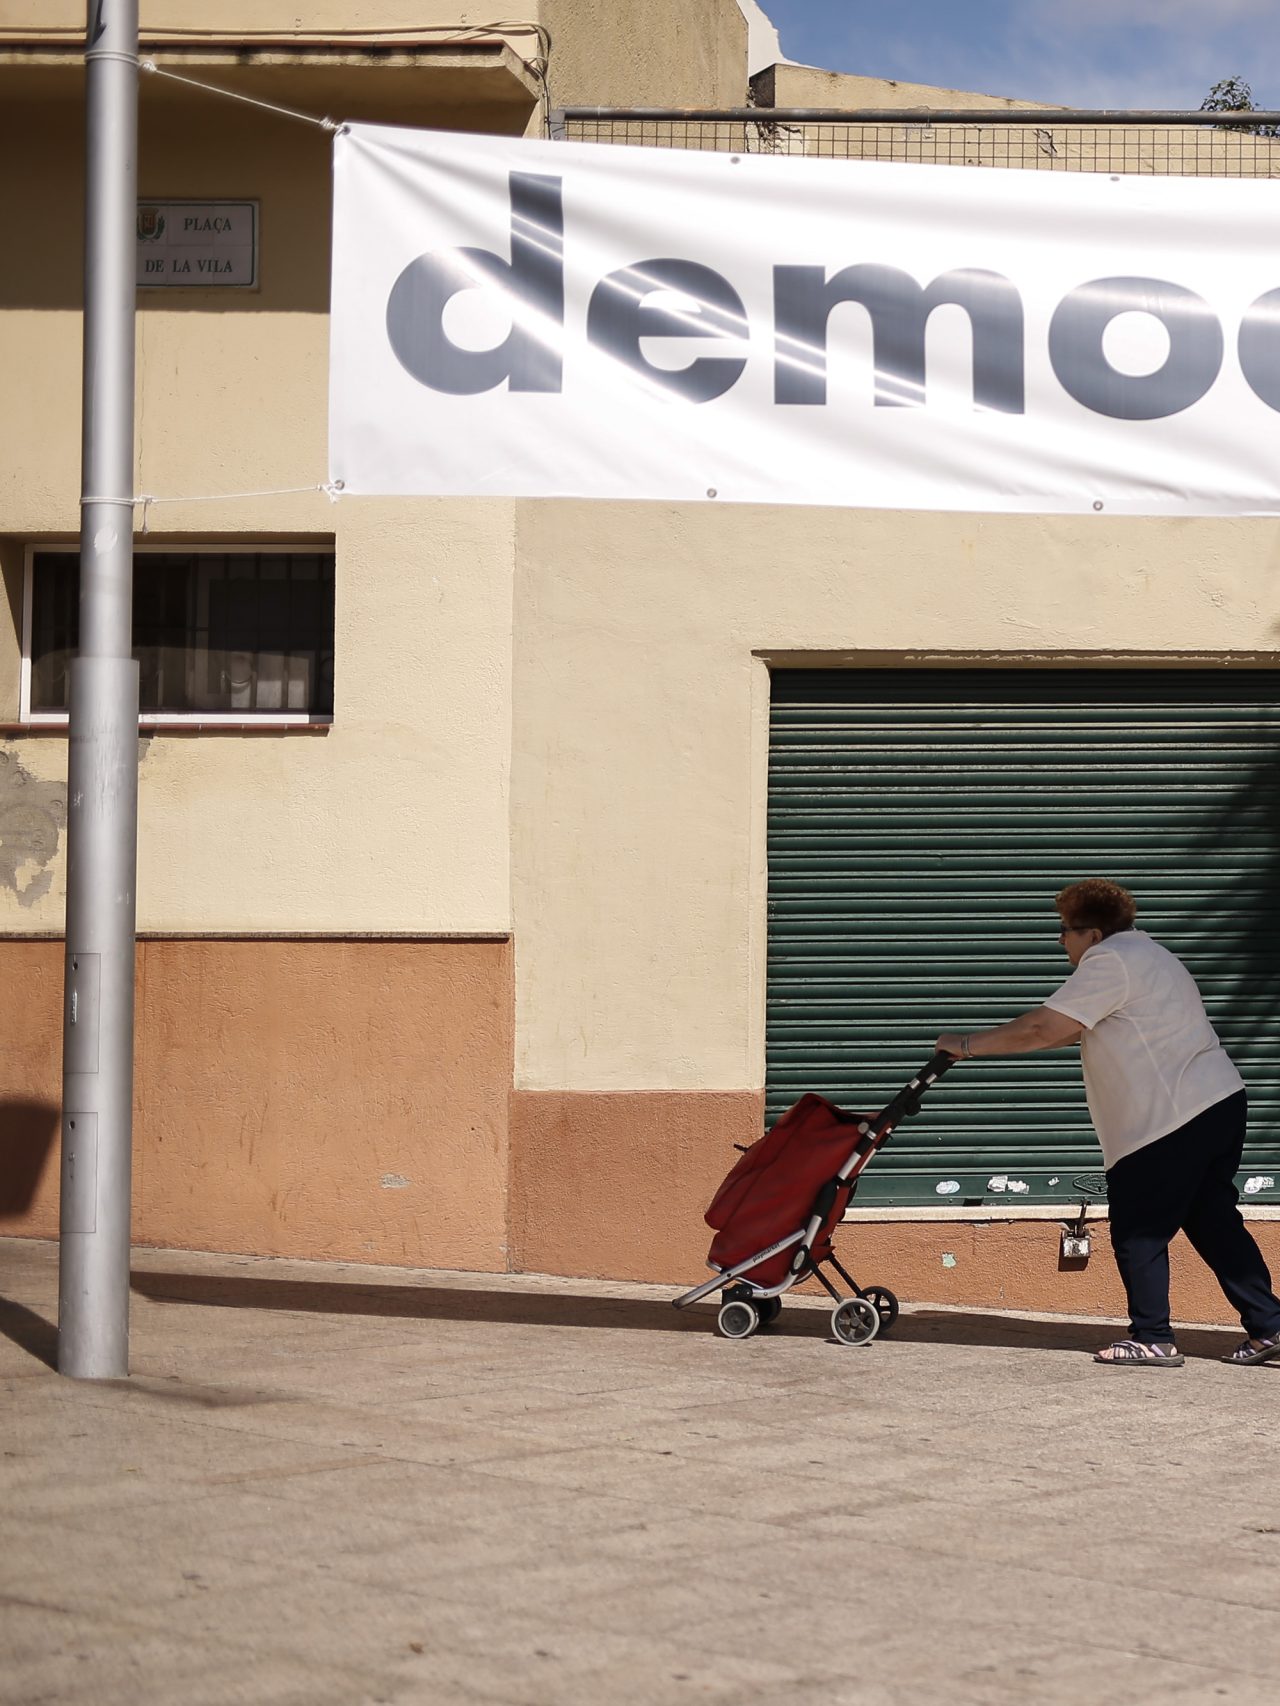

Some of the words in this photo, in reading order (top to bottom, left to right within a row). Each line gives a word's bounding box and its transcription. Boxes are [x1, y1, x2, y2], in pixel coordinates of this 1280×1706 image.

[183, 217, 233, 234] PLAÇA
[145, 259, 165, 273] DE
[173, 259, 191, 273] LA
[197, 259, 233, 273] VILA
